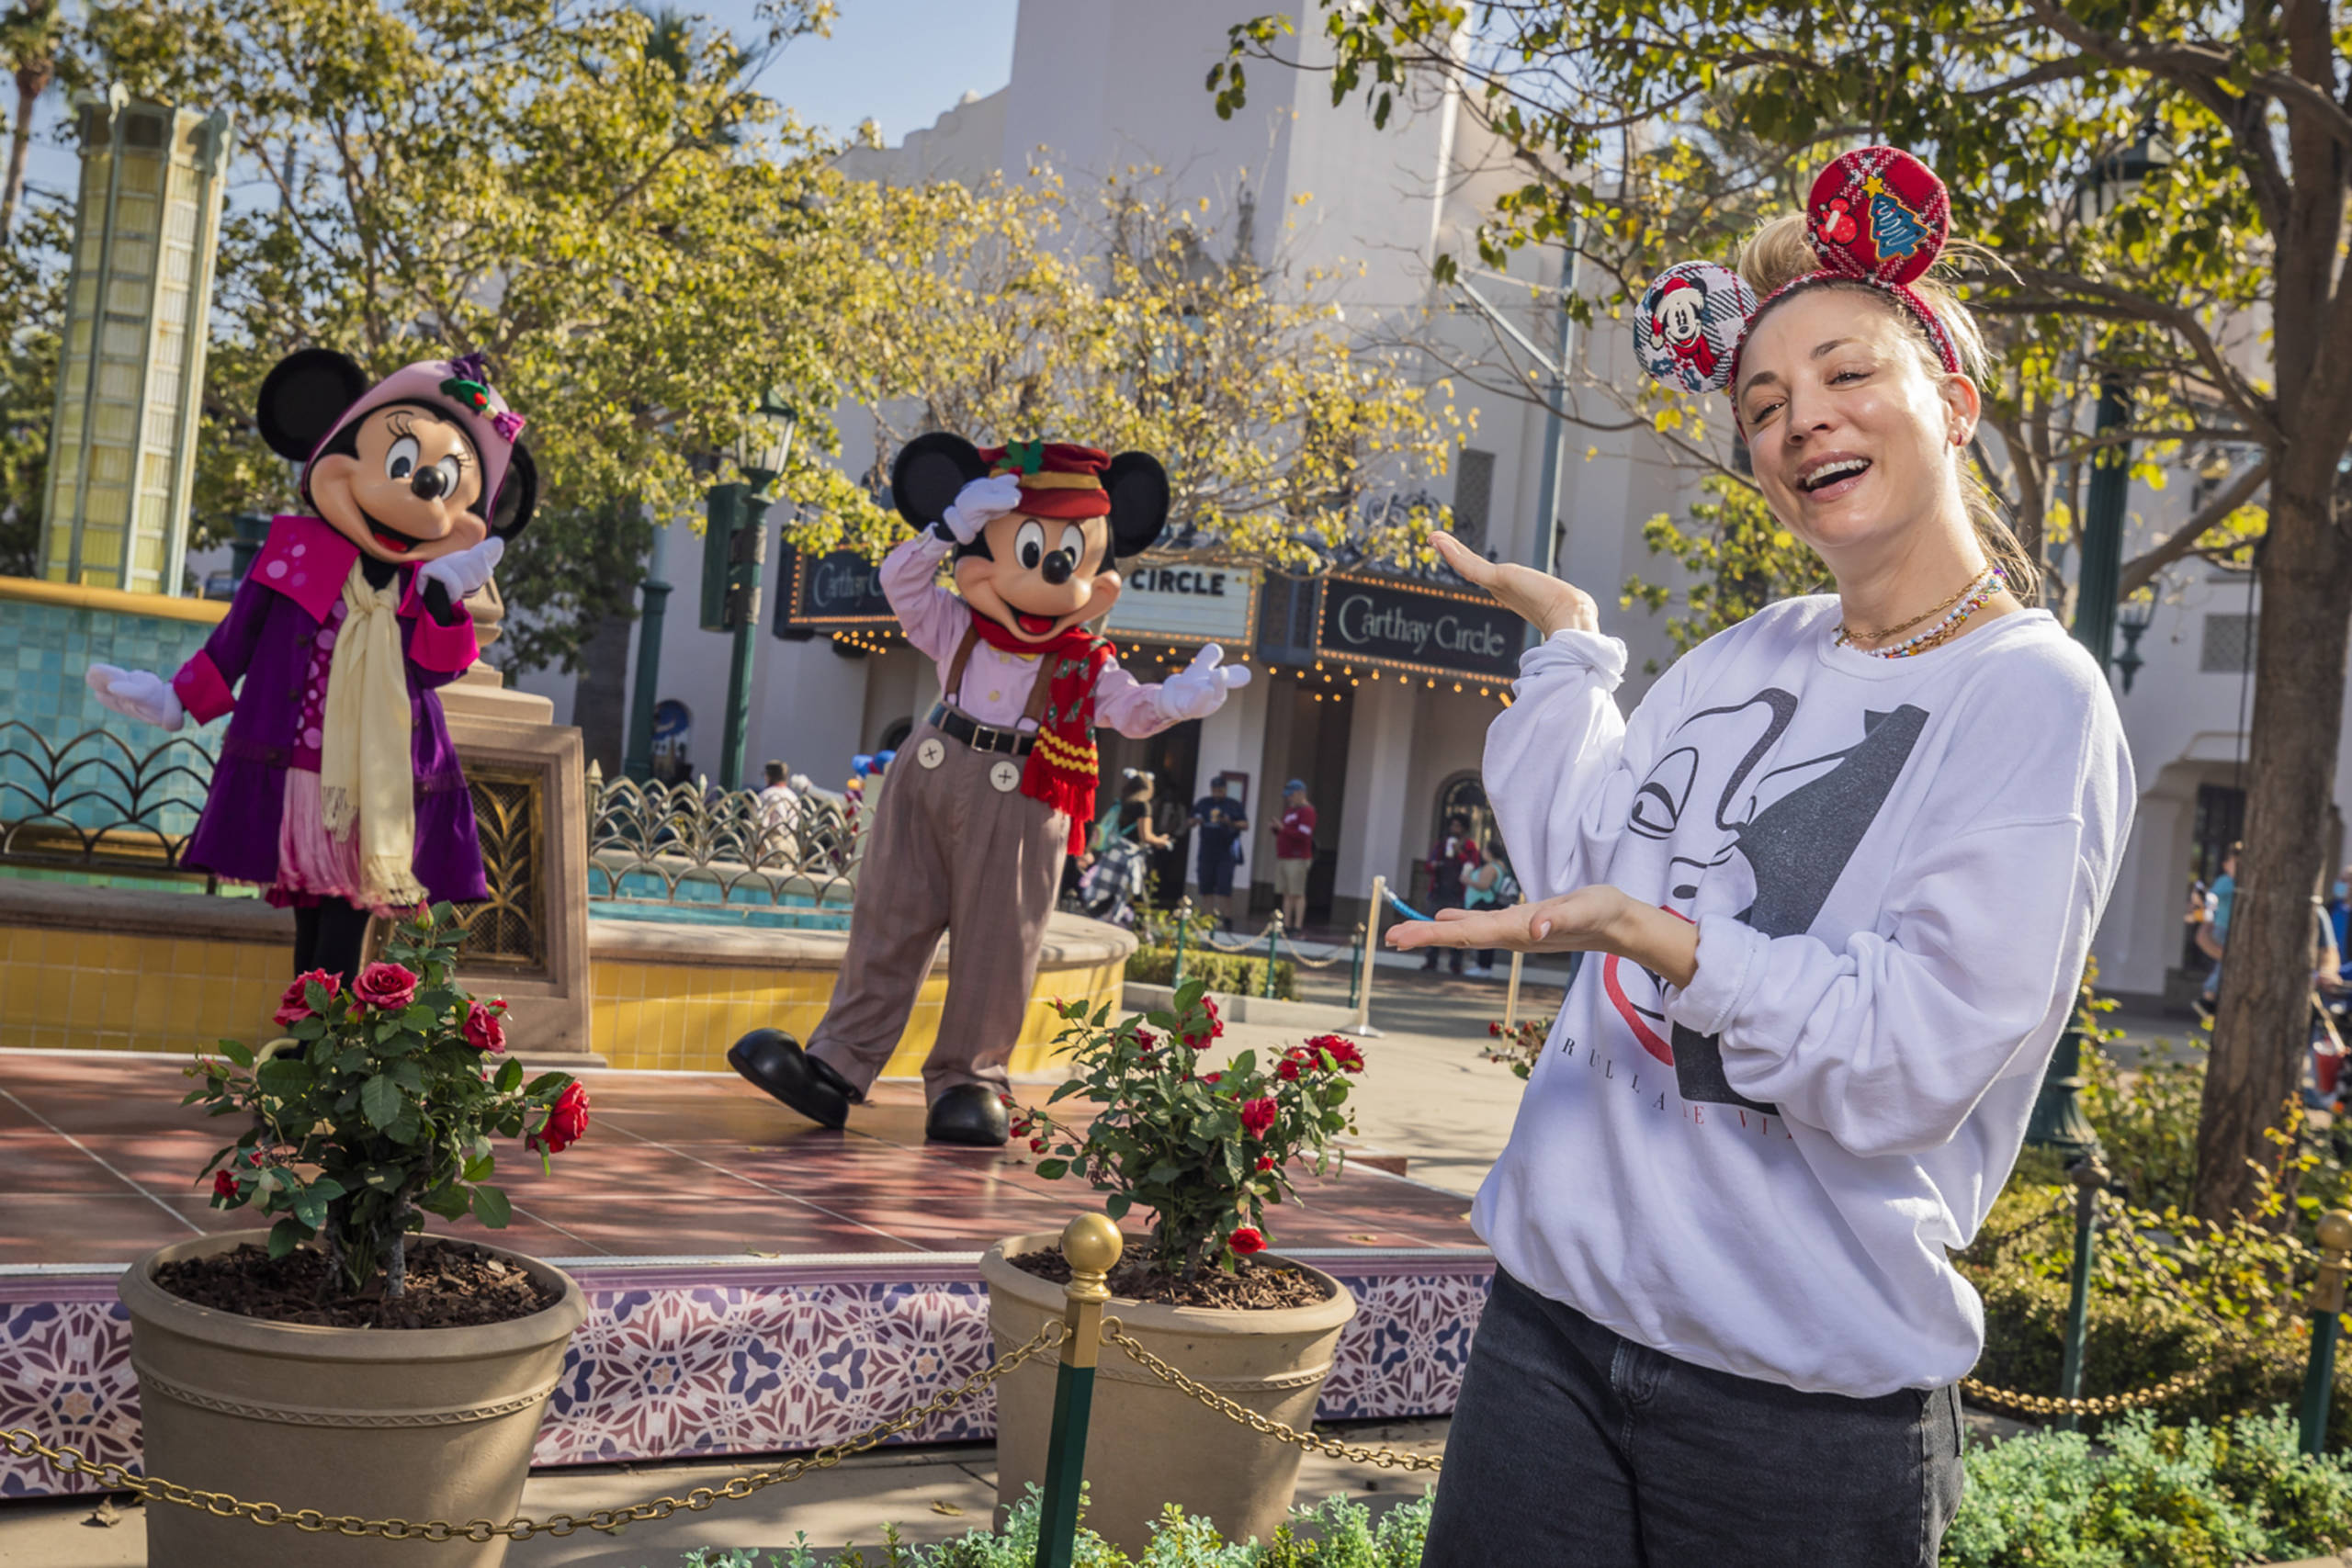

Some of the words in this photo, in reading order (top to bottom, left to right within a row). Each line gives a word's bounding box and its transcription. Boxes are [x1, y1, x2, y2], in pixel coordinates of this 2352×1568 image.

[1130, 569, 1226, 597] CIRCLE
[1339, 593, 1432, 655] Carthay
[1434, 615, 1507, 658] Circle
[1739, 1110, 1792, 1139] VI
